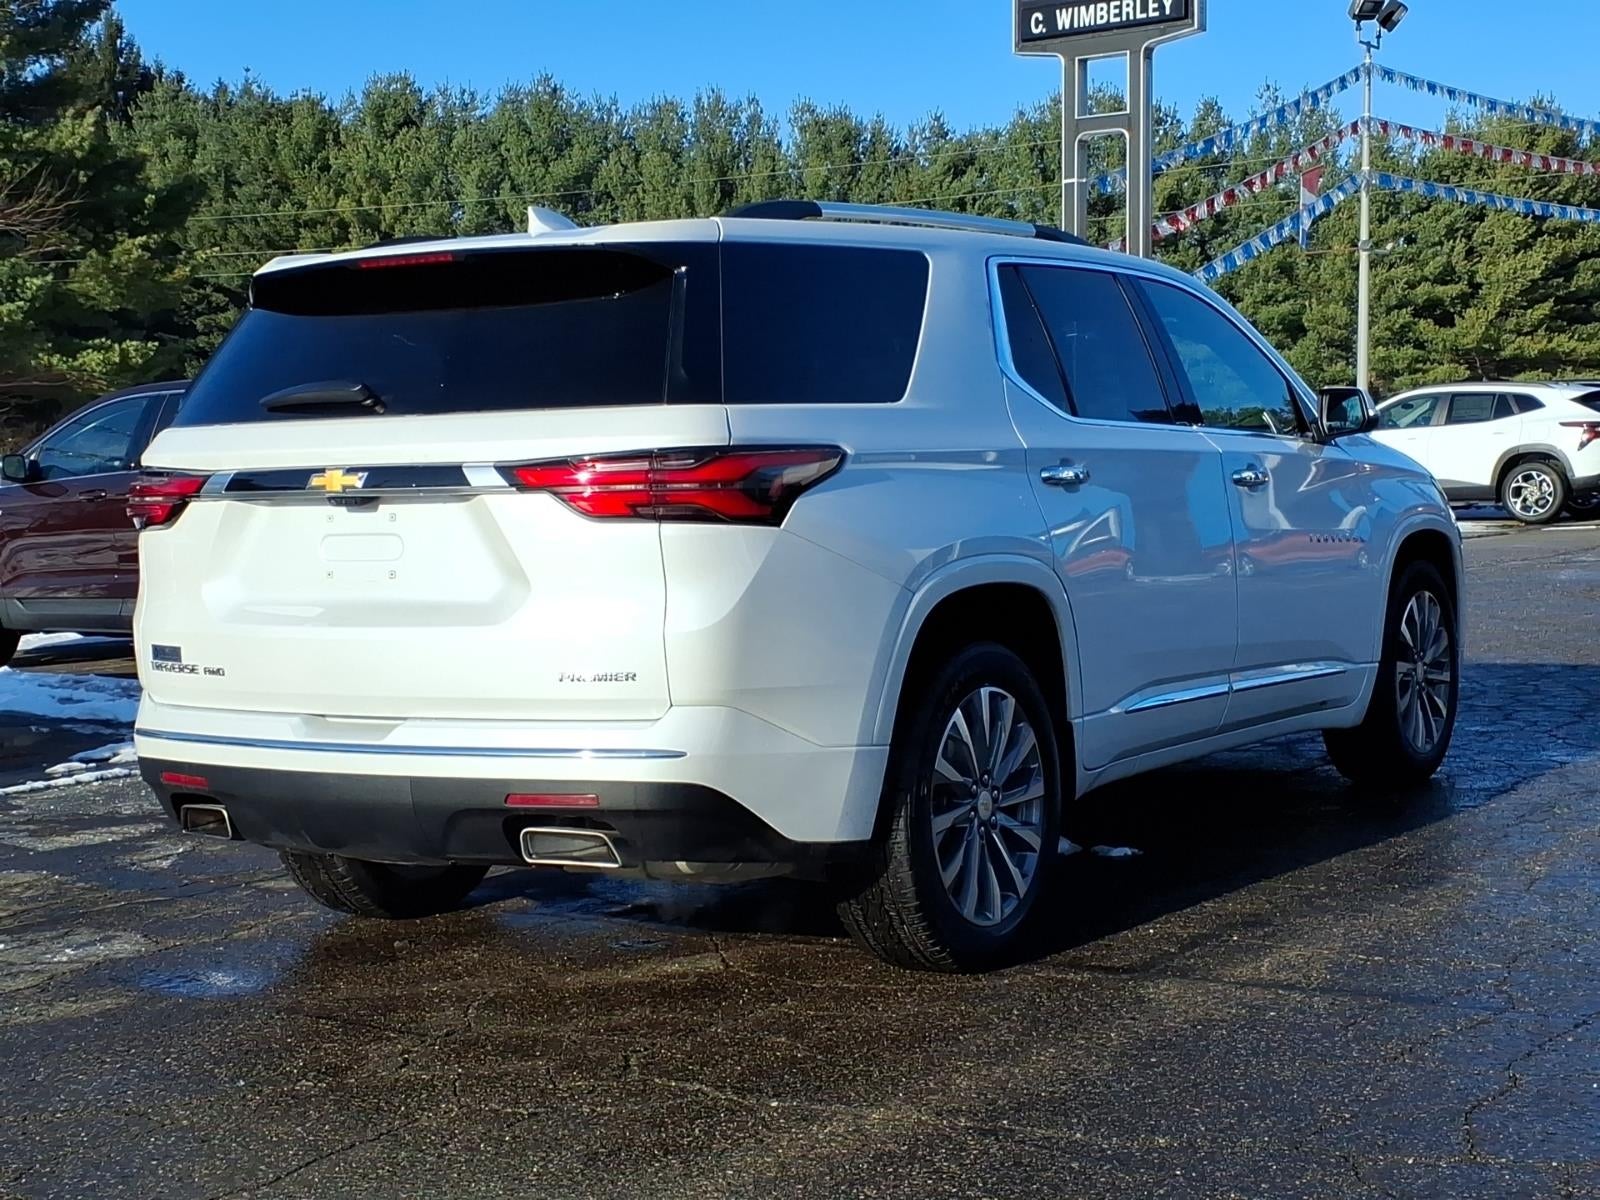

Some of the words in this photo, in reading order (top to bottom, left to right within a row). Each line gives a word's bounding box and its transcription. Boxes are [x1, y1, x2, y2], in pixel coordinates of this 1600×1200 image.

[1030, 12, 1047, 34] C.
[1055, 0, 1176, 31] WIMBERLEY
[558, 671, 638, 683] PRMIER
